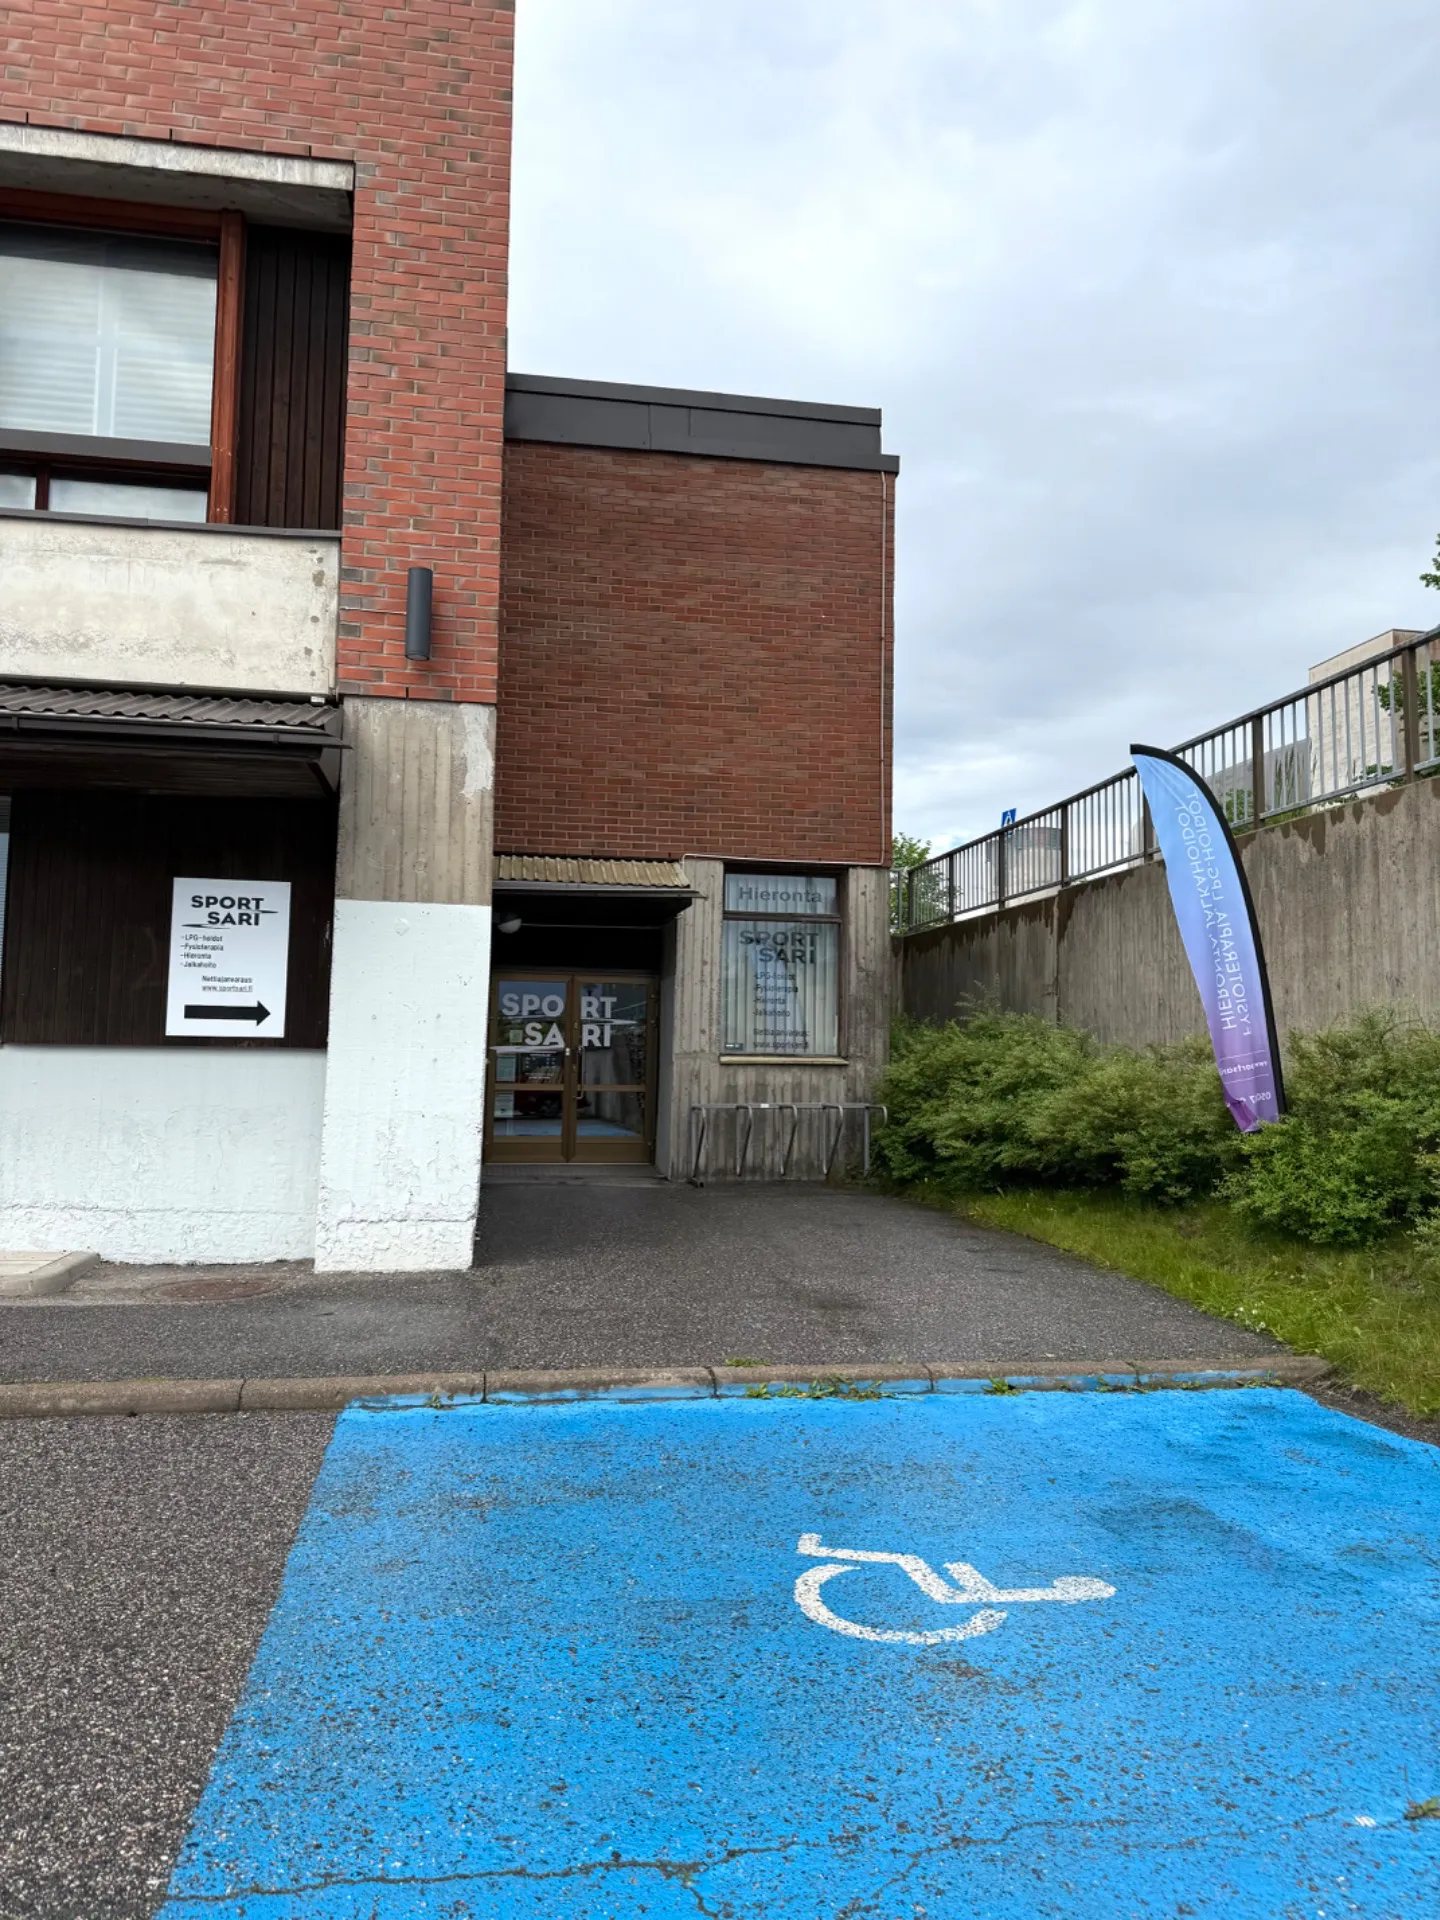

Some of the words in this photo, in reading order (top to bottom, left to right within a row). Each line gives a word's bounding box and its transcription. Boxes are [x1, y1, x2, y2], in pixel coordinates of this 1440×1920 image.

[191, 895, 265, 910] SPORT
[738, 887, 822, 903] Hieronta
[207, 912, 260, 926] SARI
[739, 930, 819, 947] SPORT
[758, 948, 816, 965] SARI
